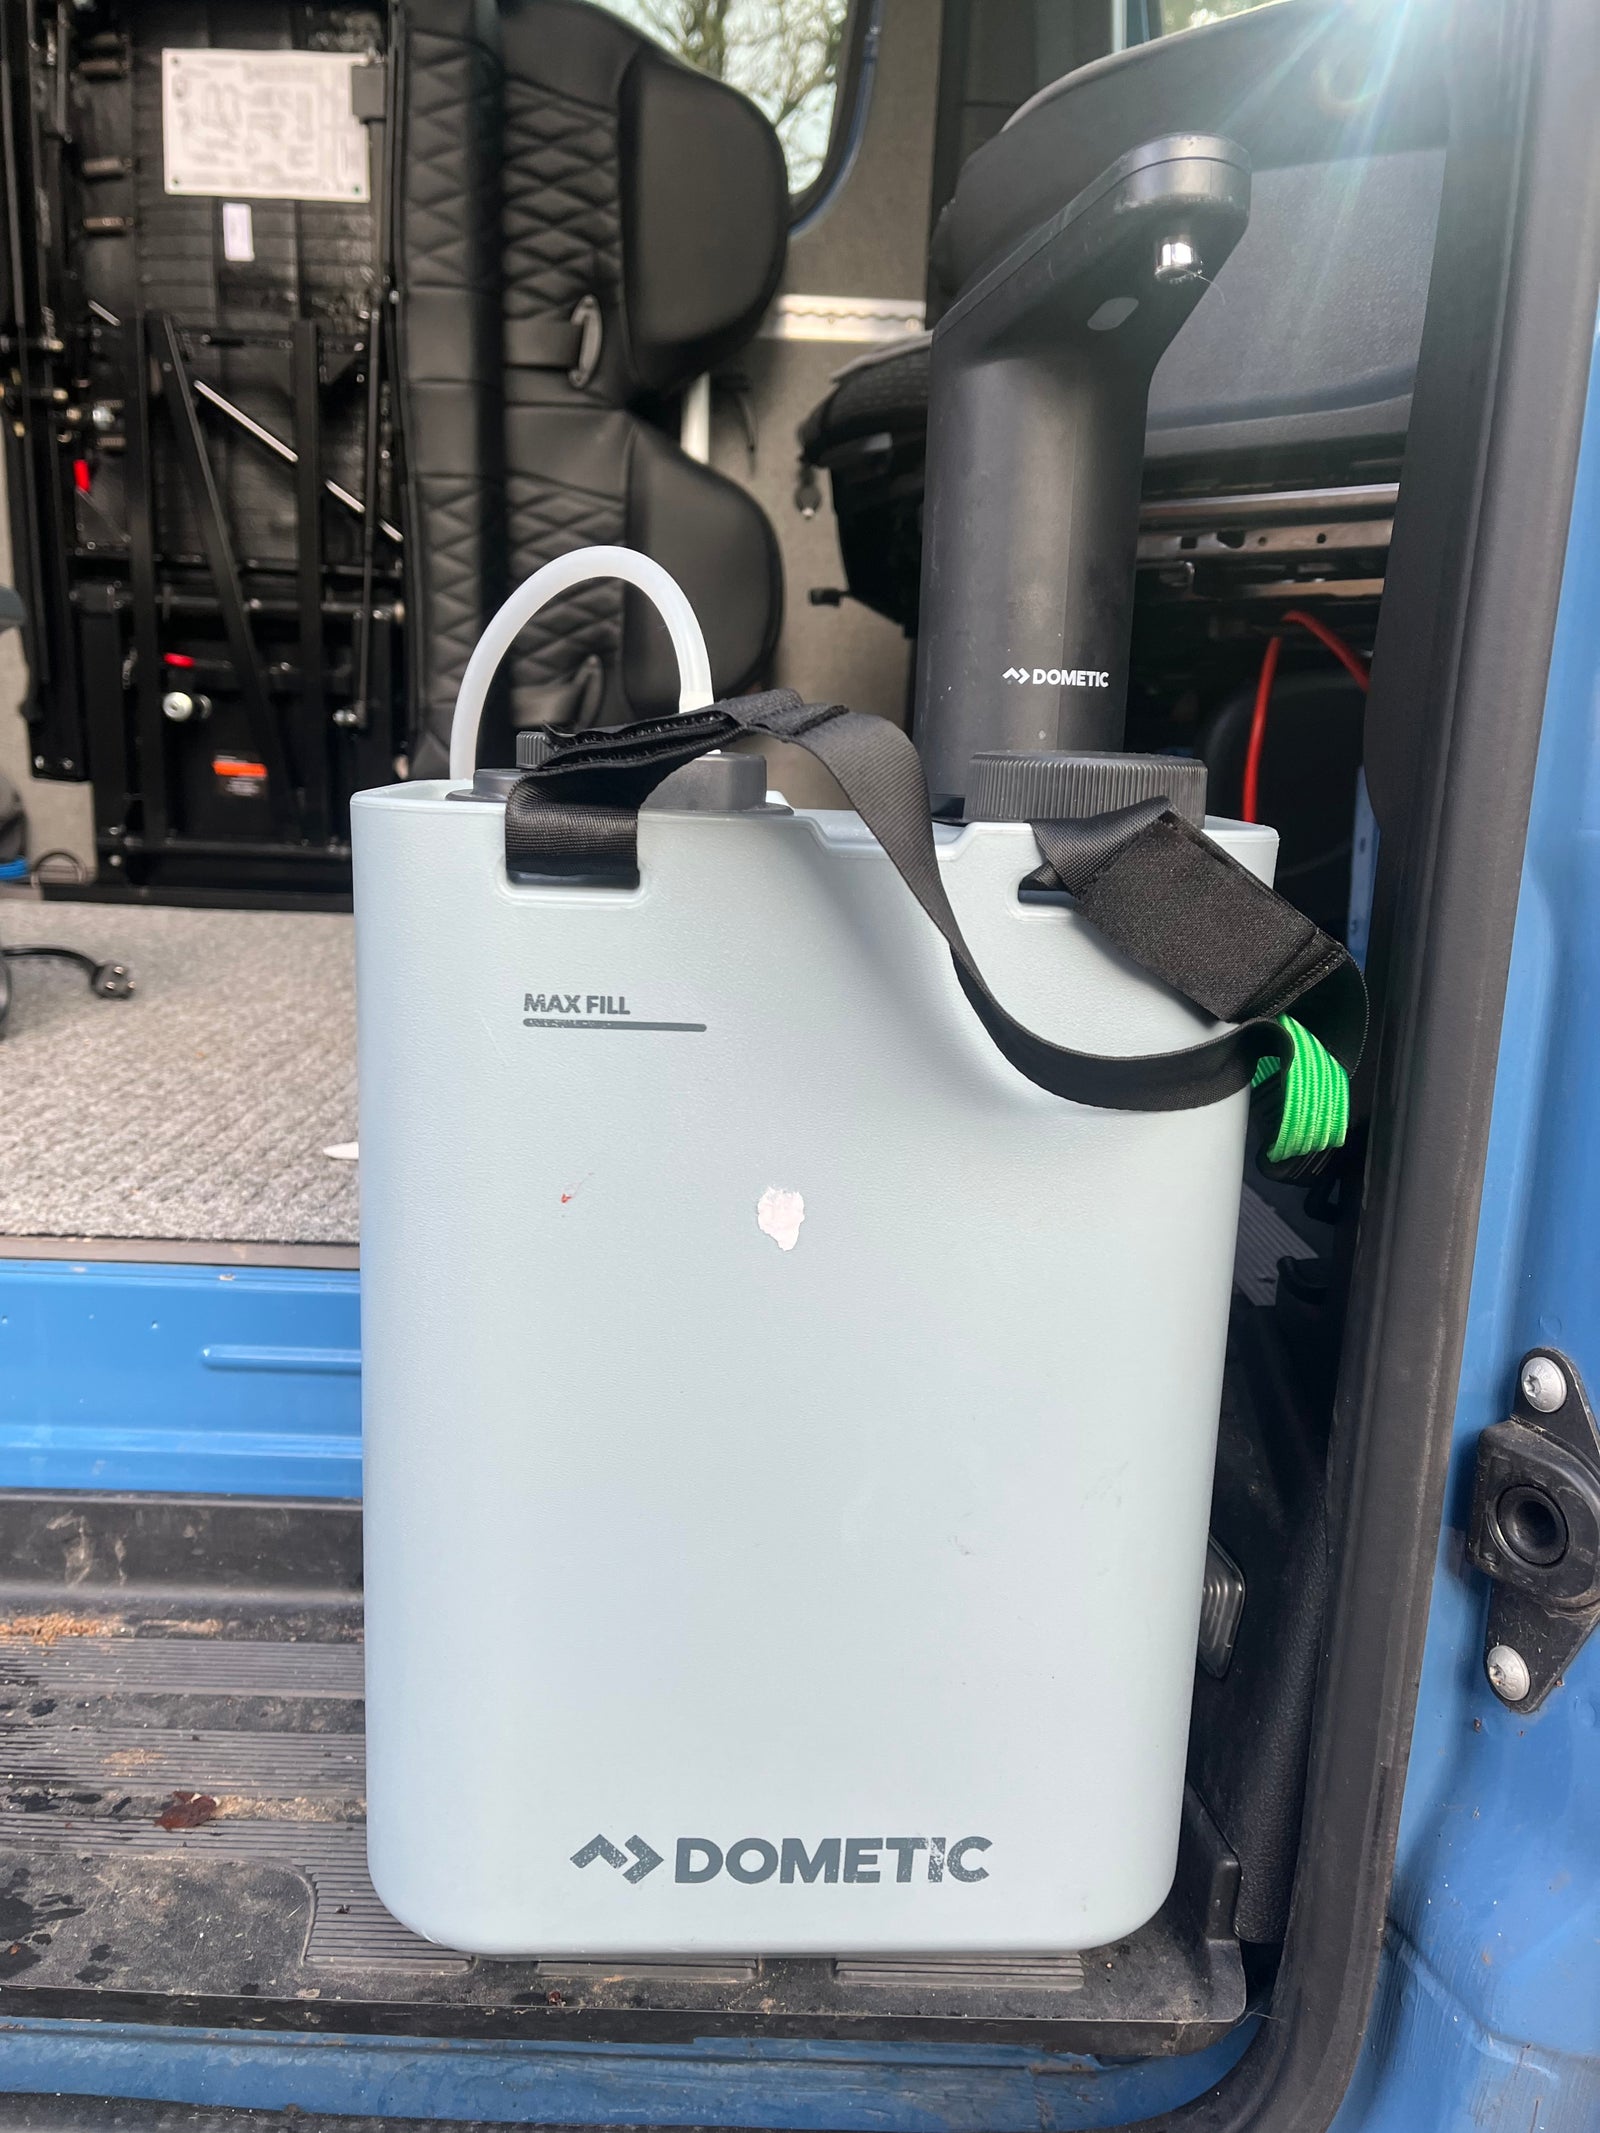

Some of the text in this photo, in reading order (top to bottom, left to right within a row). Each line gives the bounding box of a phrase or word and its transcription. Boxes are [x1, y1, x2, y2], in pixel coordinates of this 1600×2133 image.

[1032, 668, 1110, 688] DOMETIC
[523, 993, 631, 1015] MAX FILL
[674, 1836, 993, 1884] DOMETIC
